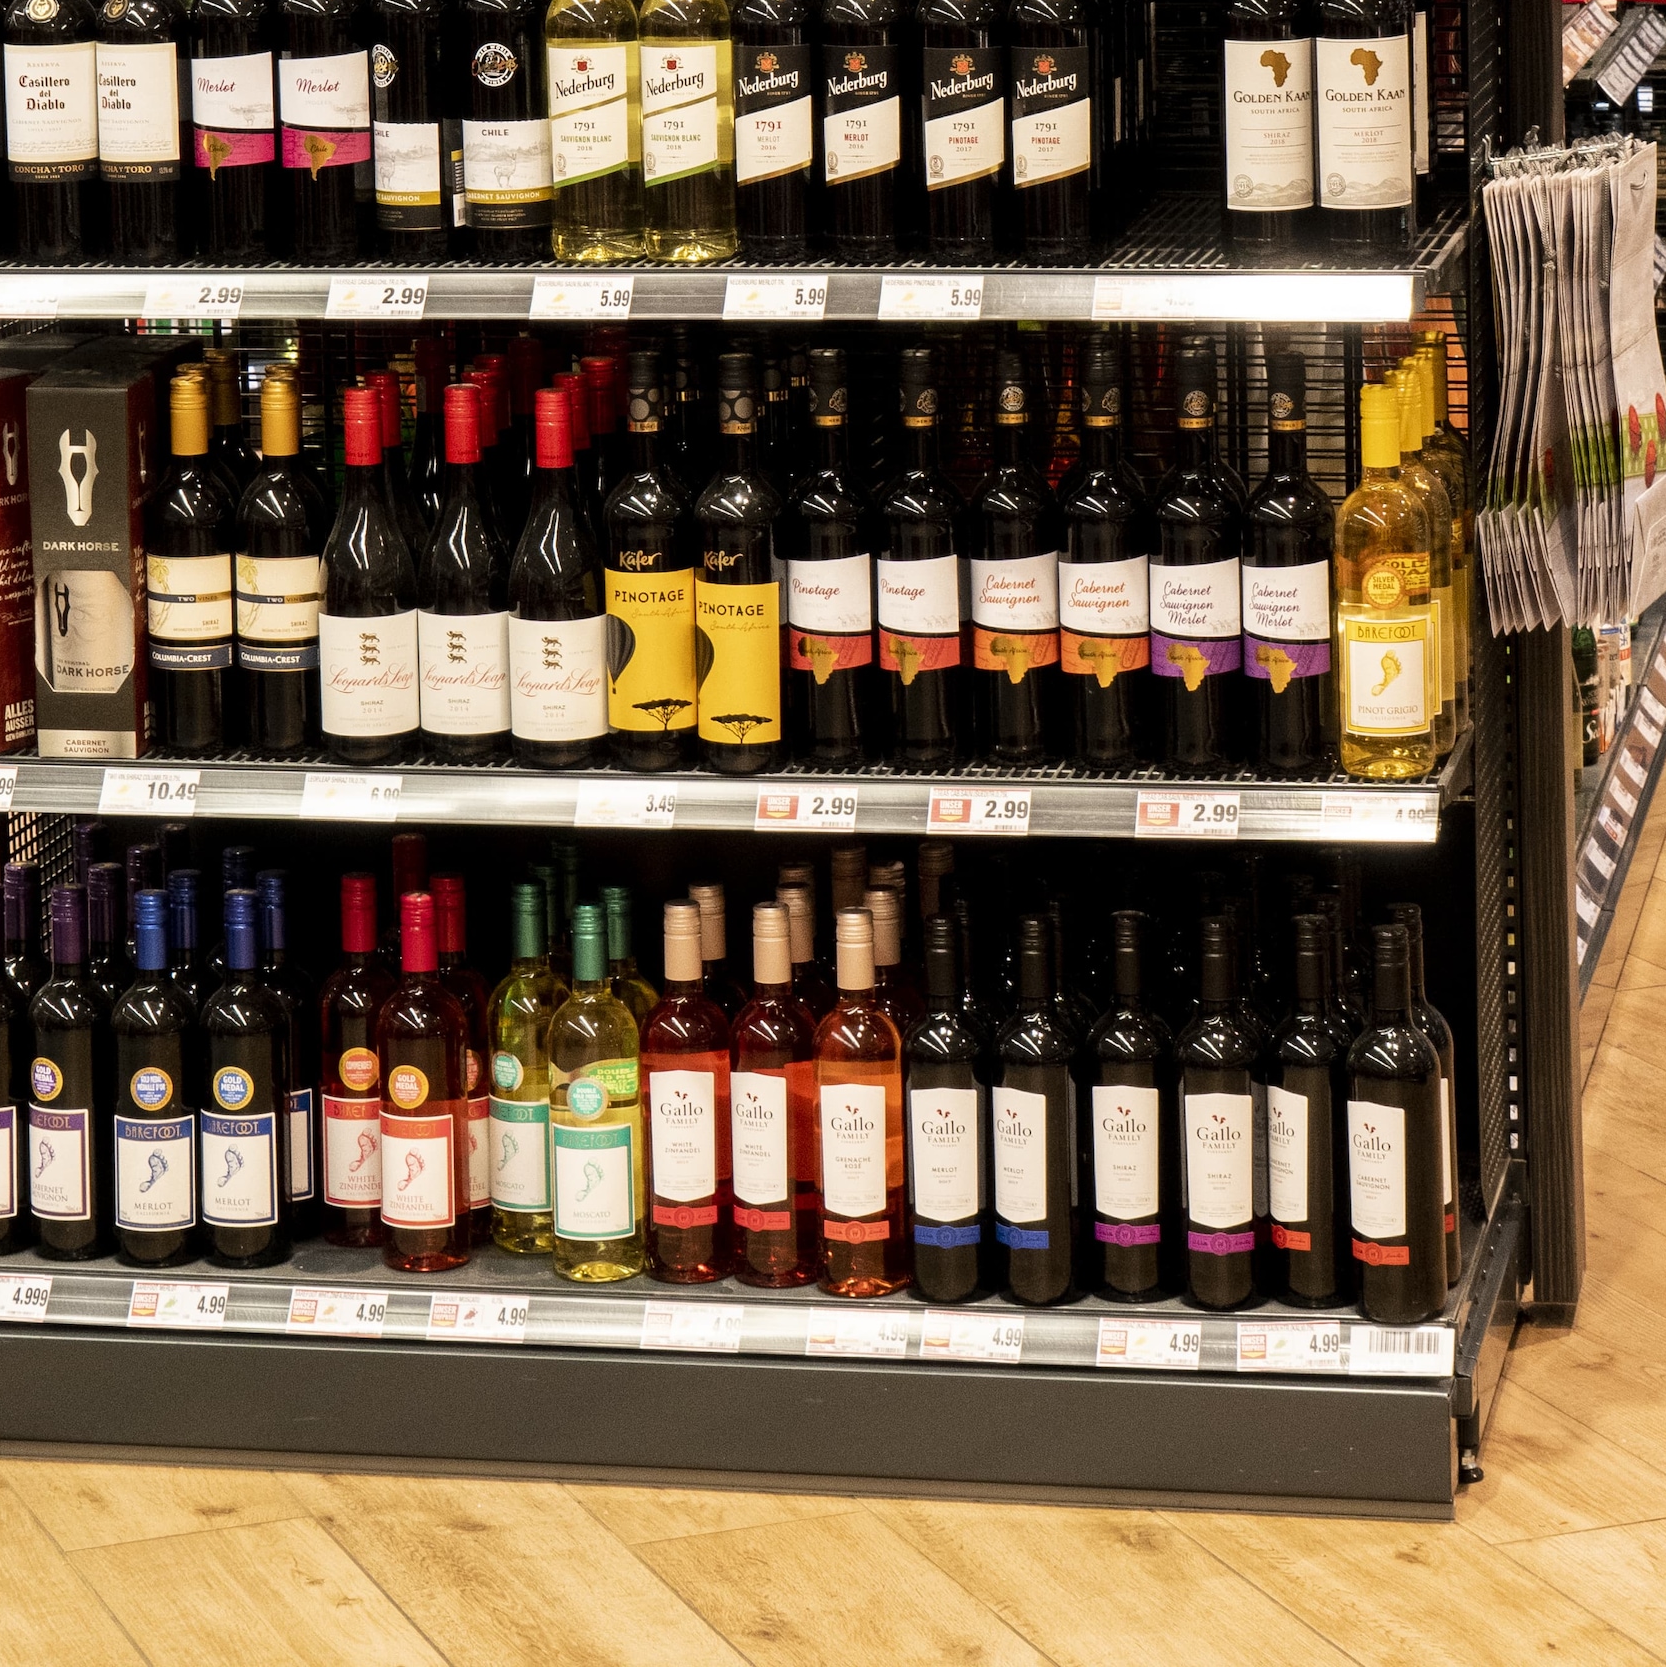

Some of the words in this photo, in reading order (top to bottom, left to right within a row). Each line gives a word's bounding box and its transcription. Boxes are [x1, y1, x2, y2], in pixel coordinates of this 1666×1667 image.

[19, 76, 70, 88] Casillero
[198, 77, 235, 93] Merlot
[296, 78, 340, 93] Merlot
[555, 72, 614, 98] Nederburg
[646, 71, 704, 97] Nederburg
[739, 70, 798, 97] Nederburg
[828, 69, 887, 96] Nederburg
[931, 71, 993, 99] Nederburg
[1016, 71, 1077, 99] Nederburg
[40, 90, 51, 98] del
[1234, 91, 1281, 103] GOLDEN
[1285, 90, 1311, 102] KAAN
[1325, 88, 1374, 102] GOLDEN
[1377, 88, 1405, 101] KAAN
[26, 98, 65, 111] Diablo
[102, 98, 131, 110] Diablo
[57, 164, 84, 173] TORO
[199, 287, 241, 303] 2.99
[382, 288, 425, 305] 2.99
[600, 290, 630, 307] 5.99
[795, 289, 825, 305] 5.99
[951, 289, 981, 306] 5.99
[43, 542, 75, 551] DARK
[77, 542, 119, 551] HORSE
[620, 551, 662, 571] Käfer
[704, 551, 743, 571] Käfer
[793, 579, 840, 600] Pinotage
[881, 579, 925, 600] Pinotage
[986, 576, 1035, 590] Cabernet
[1164, 582, 1211, 597] Cabernet
[615, 590, 684, 602] PINOTAGE
[980, 589, 1041, 610] Sauvignon
[699, 602, 764, 616] PINOTAGE
[1160, 596, 1214, 613] Sauvignon
[1168, 612, 1207, 626] Merlot
[1358, 625, 1416, 639] BAREFOOT
[57, 666, 83, 677] DARK
[86, 665, 129, 677] HORSE
[5, 700, 34, 719] ALLES
[1358, 706, 1384, 714] PINOT
[1387, 705, 1418, 714] GRIGIO
[6, 715, 34, 732] AUSSER
[148, 782, 197, 800] 10.49
[646, 795, 675, 812] 3.49
[812, 798, 855, 815] 2.99
[398, 1075, 415, 1083] GOLD
[660, 1103, 703, 1117] Gallo
[831, 1117, 875, 1131] Gallo
[921, 1121, 966, 1135] Gallo
[1103, 1118, 1147, 1132] Gallo
[837, 1132, 870, 1140] FAMILY
[1353, 1134, 1391, 1151] Gallo
[215, 1198, 251, 1206] MERLOT
[396, 1194, 423, 1203] WHITE
